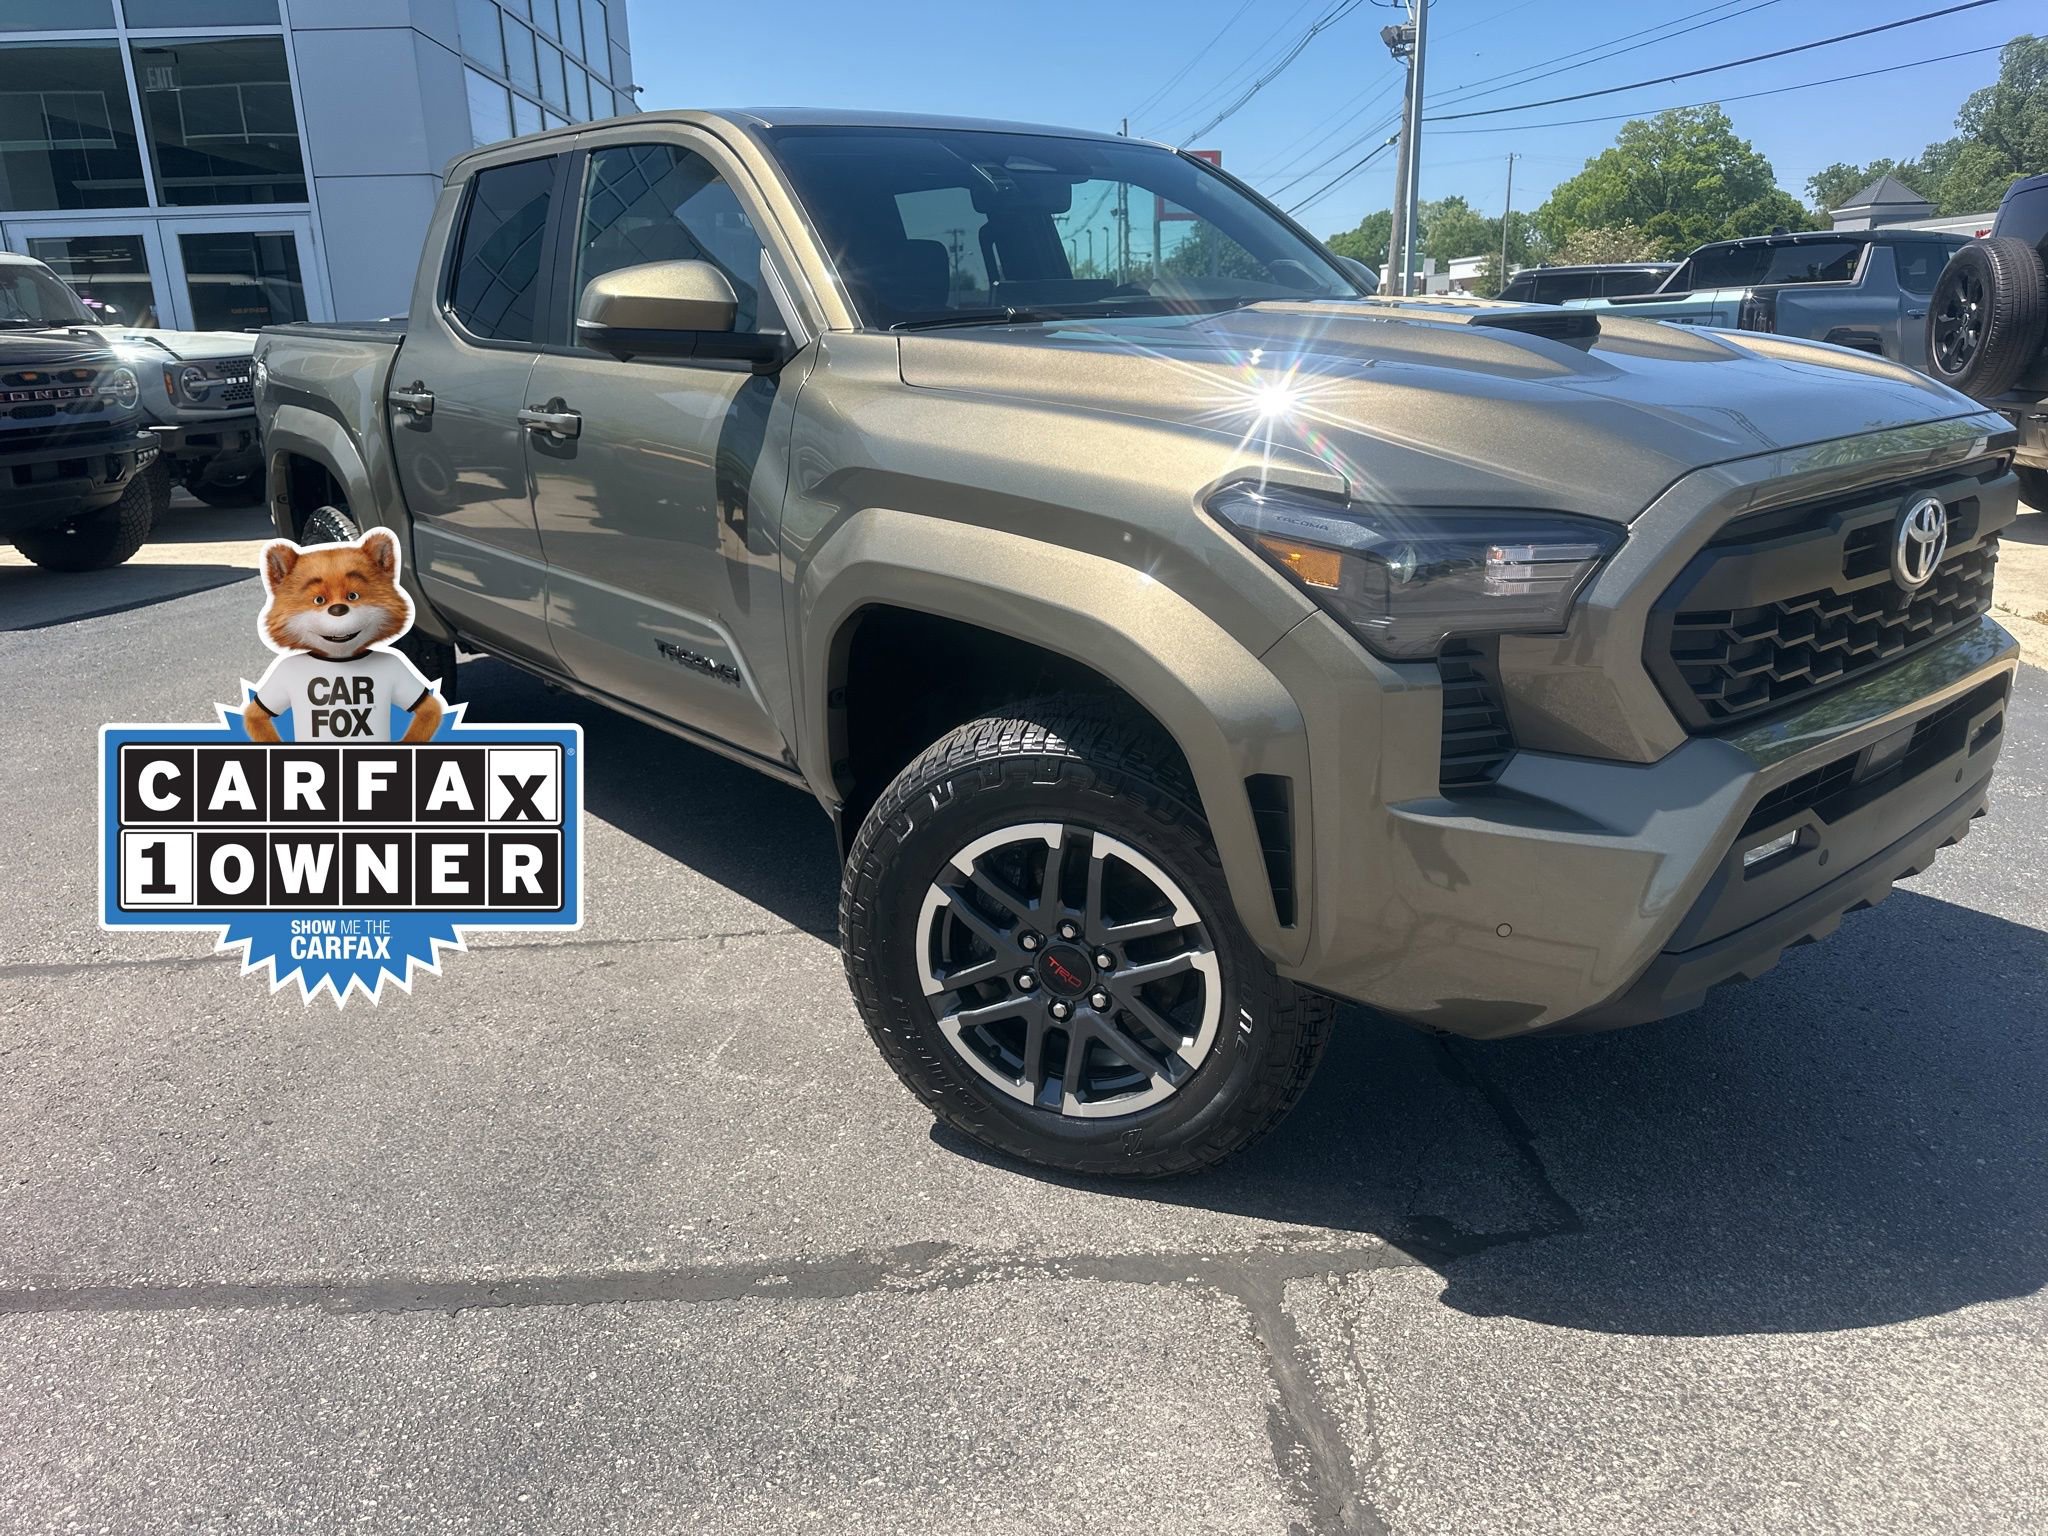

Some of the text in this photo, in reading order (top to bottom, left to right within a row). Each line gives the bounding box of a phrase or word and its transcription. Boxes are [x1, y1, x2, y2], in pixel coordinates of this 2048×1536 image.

[147, 66, 175, 89] EXIT
[0, 386, 97, 402] ONCO
[1274, 514, 1329, 532] TACOMA
[1048, 955, 1083, 989] TRD
